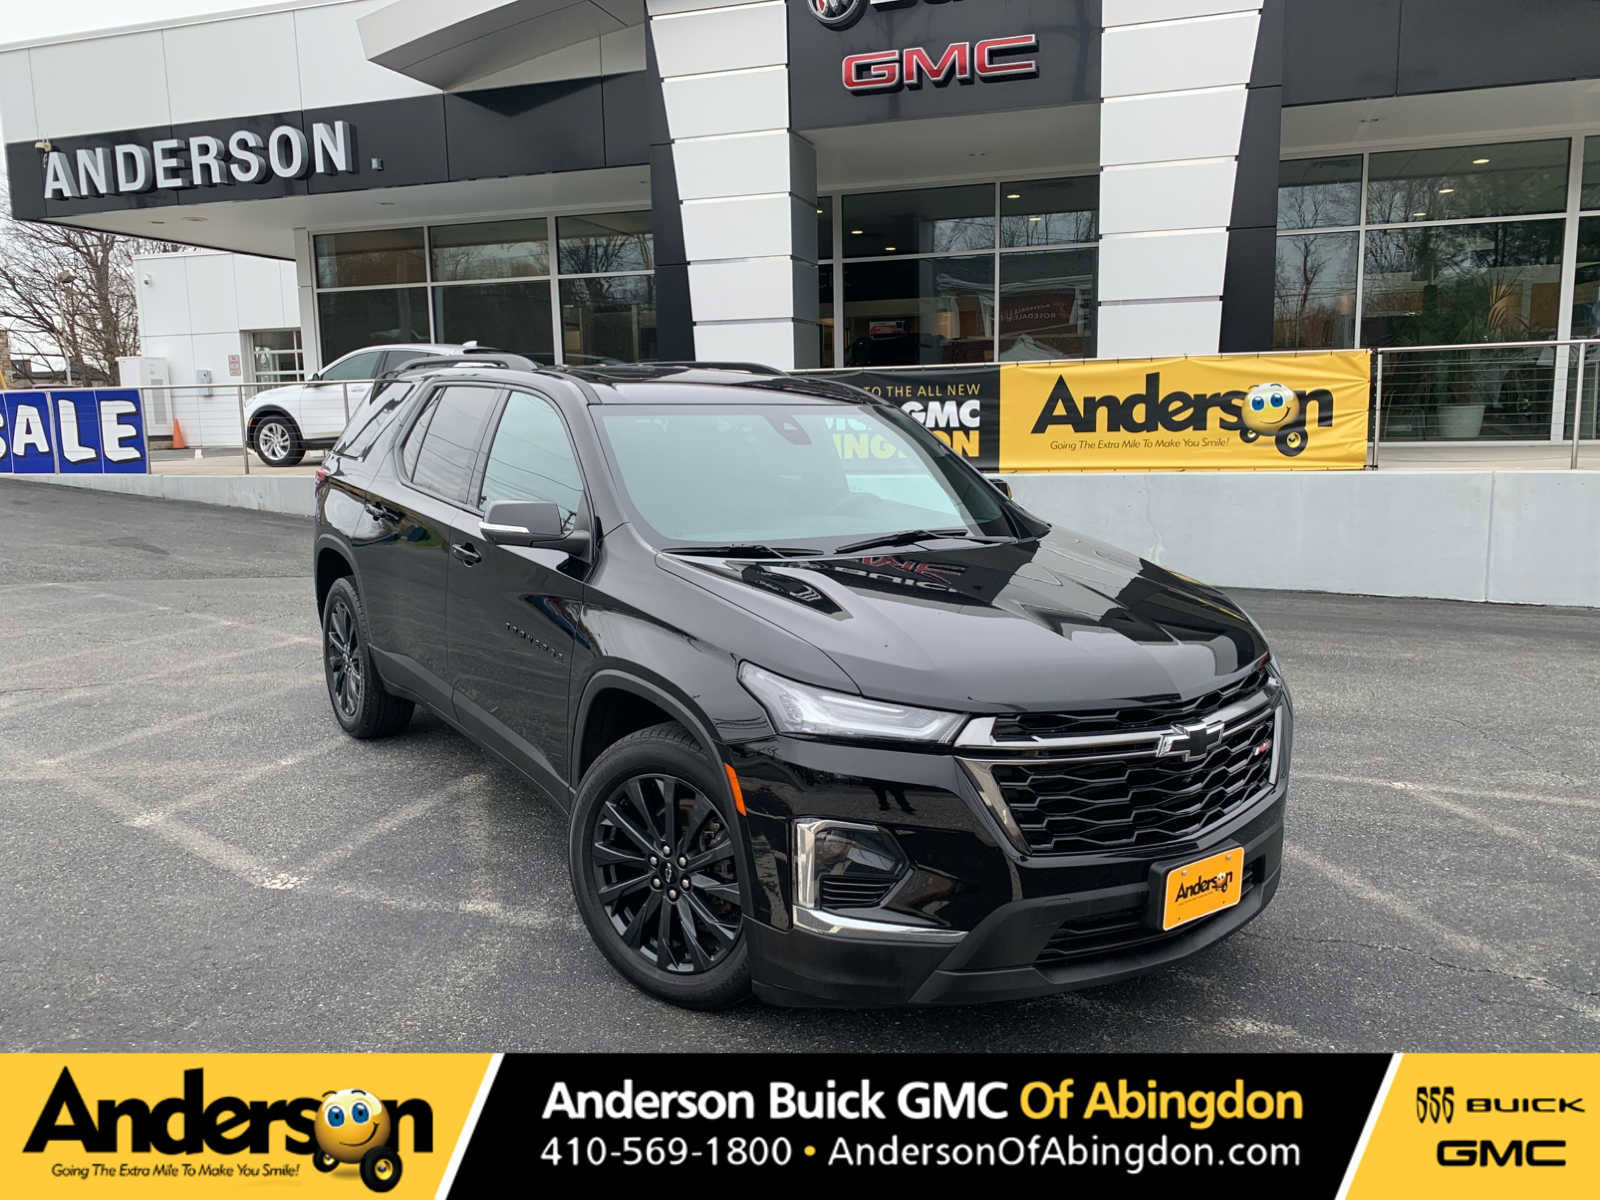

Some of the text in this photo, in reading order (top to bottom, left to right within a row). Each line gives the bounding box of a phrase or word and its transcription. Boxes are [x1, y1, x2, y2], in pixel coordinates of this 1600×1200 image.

[842, 34, 1038, 90] GMC
[44, 121, 351, 199] ANDERSON
[886, 386, 912, 397] THE
[917, 385, 942, 396] ALL
[947, 383, 981, 396] NEW
[0, 399, 142, 463] ALE
[901, 400, 981, 428] GMC
[1050, 437, 1230, 451] Going The Extra Mile To Make You Smile!
